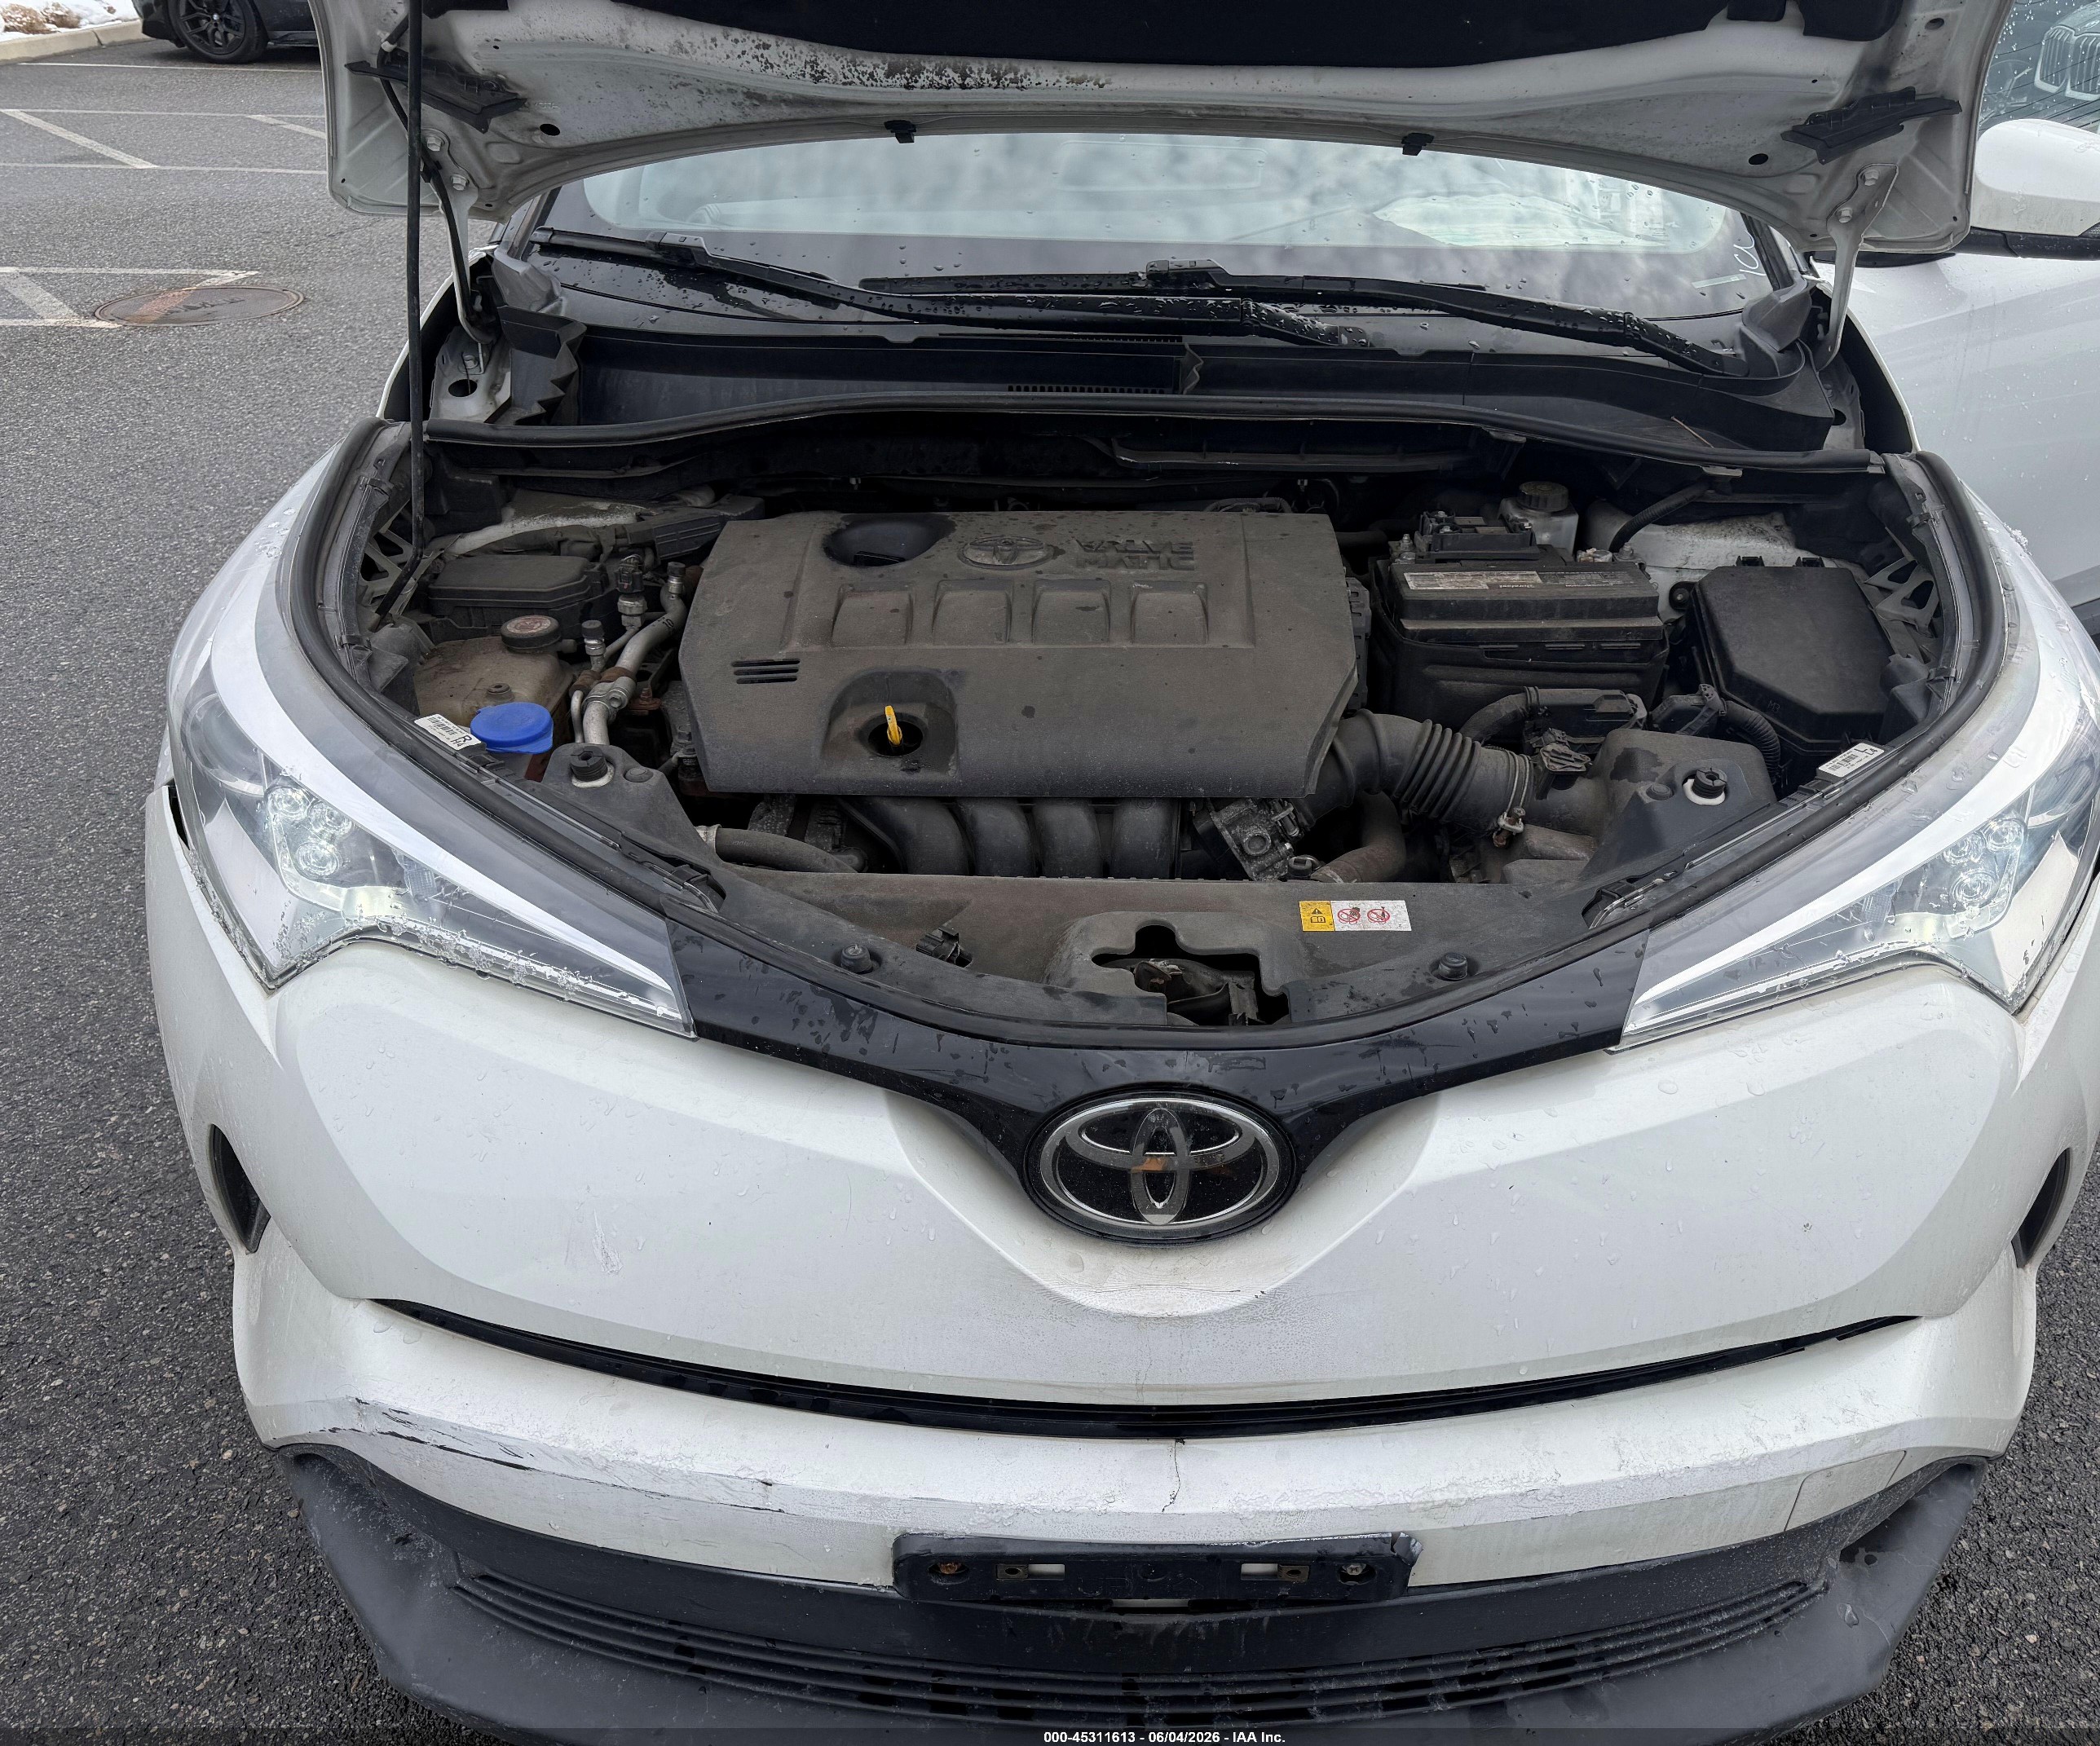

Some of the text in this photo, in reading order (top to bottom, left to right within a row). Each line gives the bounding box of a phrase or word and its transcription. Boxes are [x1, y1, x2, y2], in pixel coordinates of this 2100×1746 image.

[1074, 539, 1193, 554] VALVE
[1074, 554, 1195, 571] MATIC
[450, 739, 466, 747] H4
[458, 734, 473, 743] R
